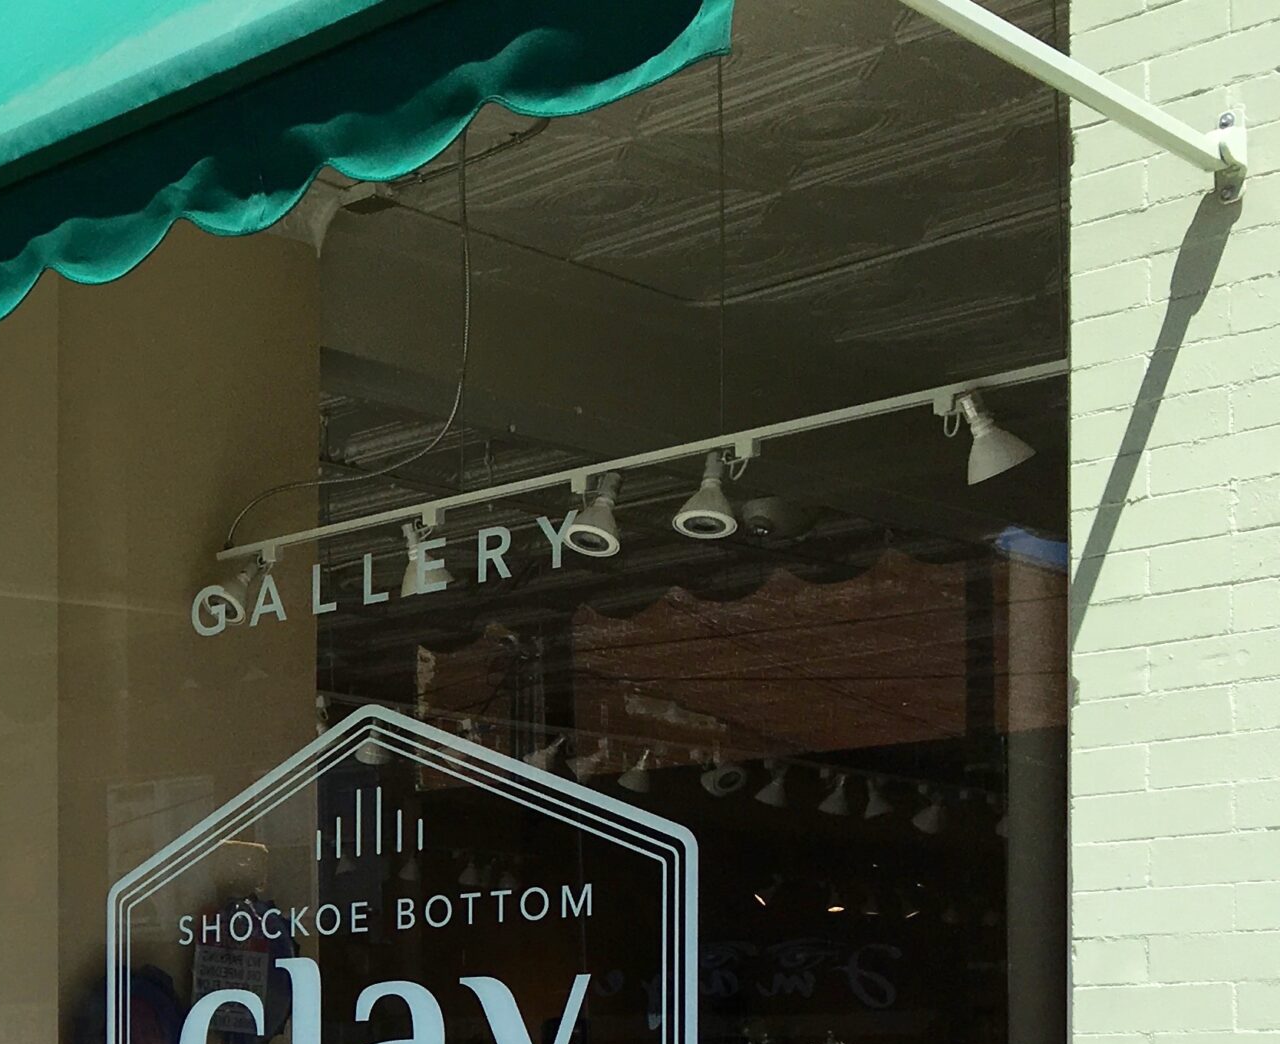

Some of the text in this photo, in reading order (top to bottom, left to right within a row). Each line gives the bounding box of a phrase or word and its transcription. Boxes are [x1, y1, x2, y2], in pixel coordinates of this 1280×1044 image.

[191, 510, 578, 637] GALLERY
[178, 883, 593, 946] SHOCKOE BOTTOM
